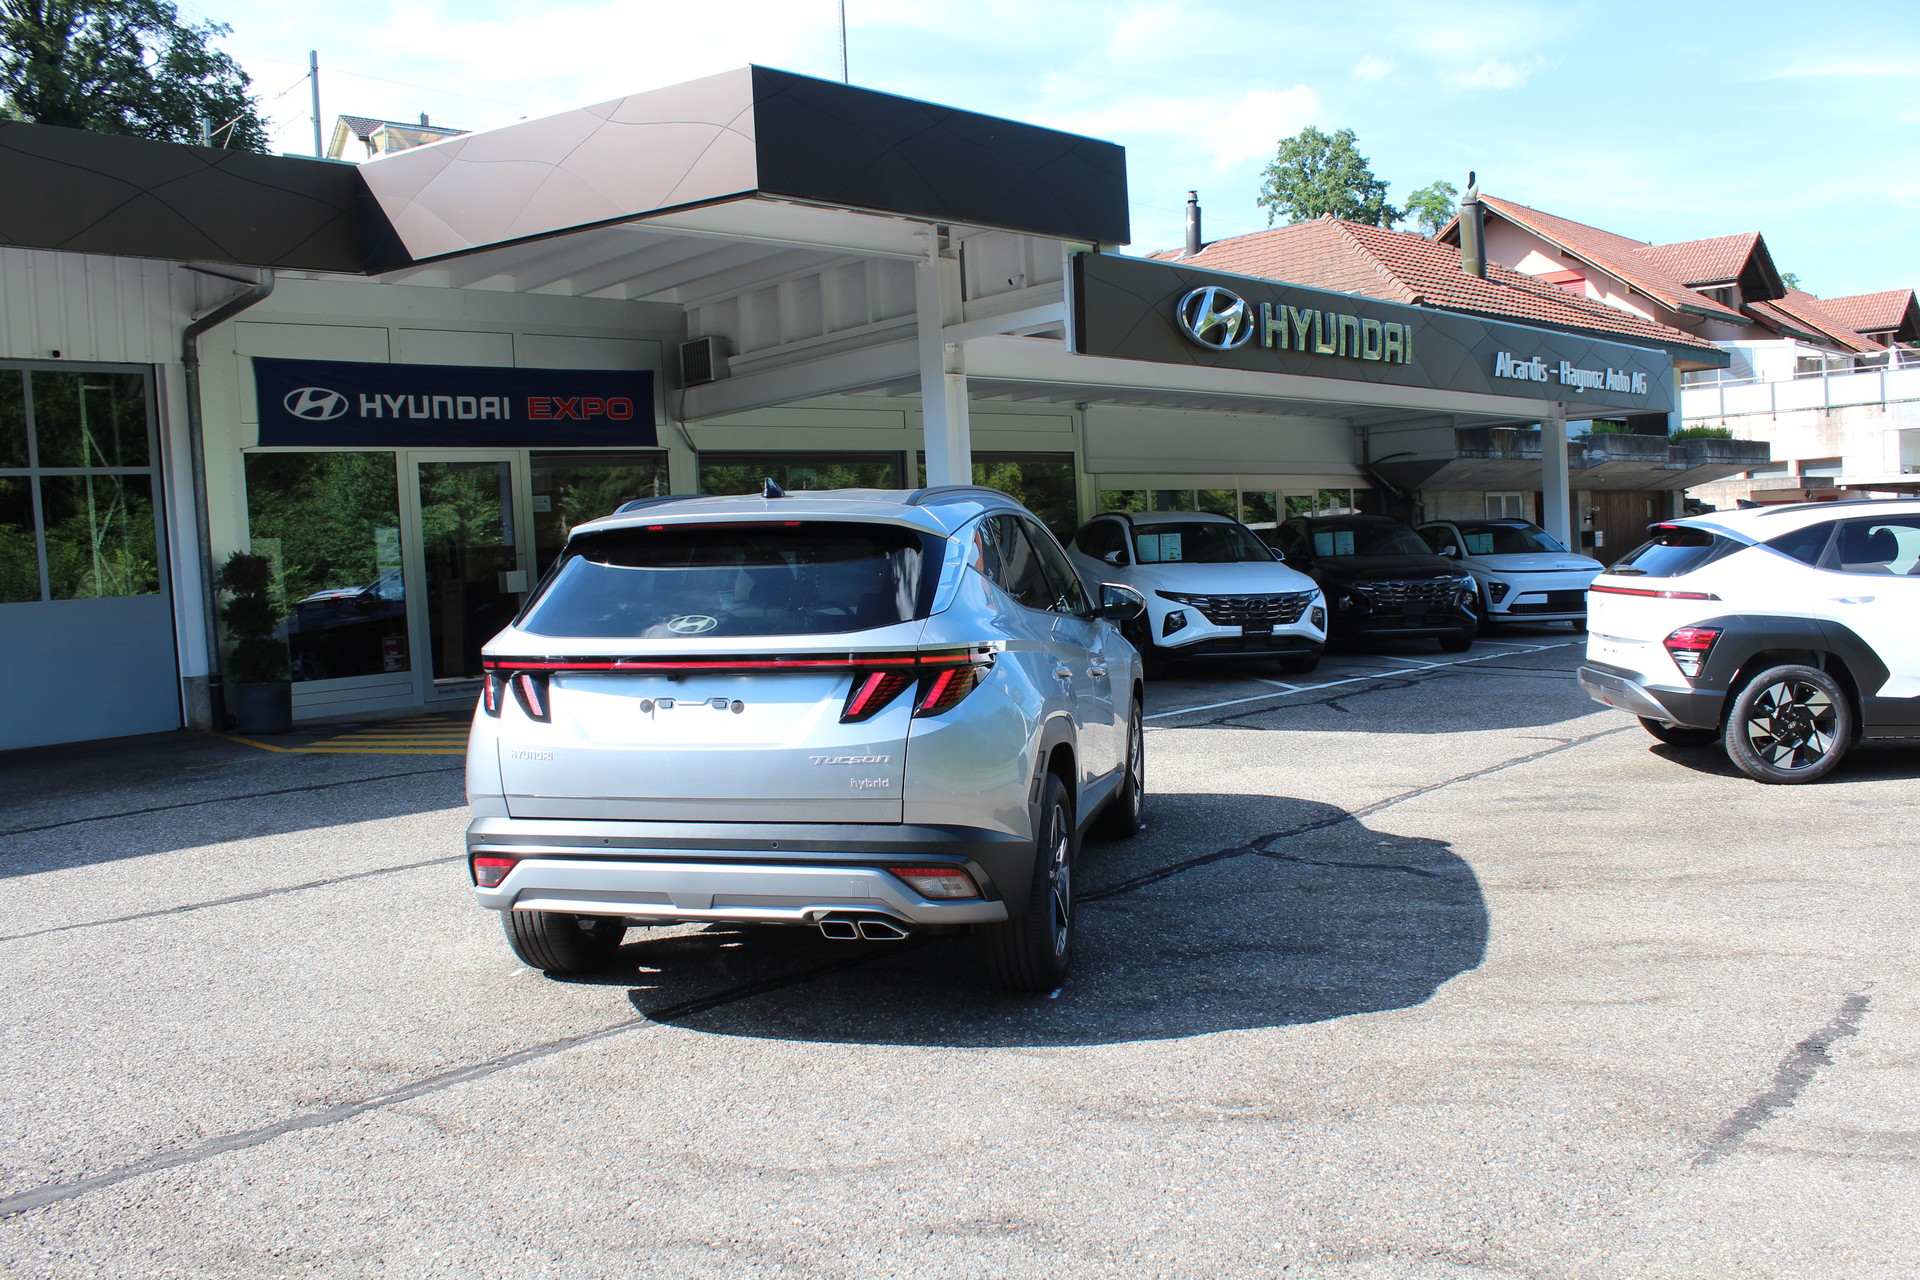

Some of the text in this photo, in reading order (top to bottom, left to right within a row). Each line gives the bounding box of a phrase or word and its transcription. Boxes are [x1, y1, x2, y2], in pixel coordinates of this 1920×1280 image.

[1260, 302, 1412, 365] HYUNDAI
[1495, 351, 1548, 383] Alcardis
[1559, 360, 1604, 393] Haymoz
[1605, 367, 1630, 393] Auto
[1631, 371, 1647, 395] AG
[359, 393, 633, 420] HYUNDAI EXPO
[511, 750, 554, 760] HYUNDAI
[850, 778, 889, 789] hybrid
